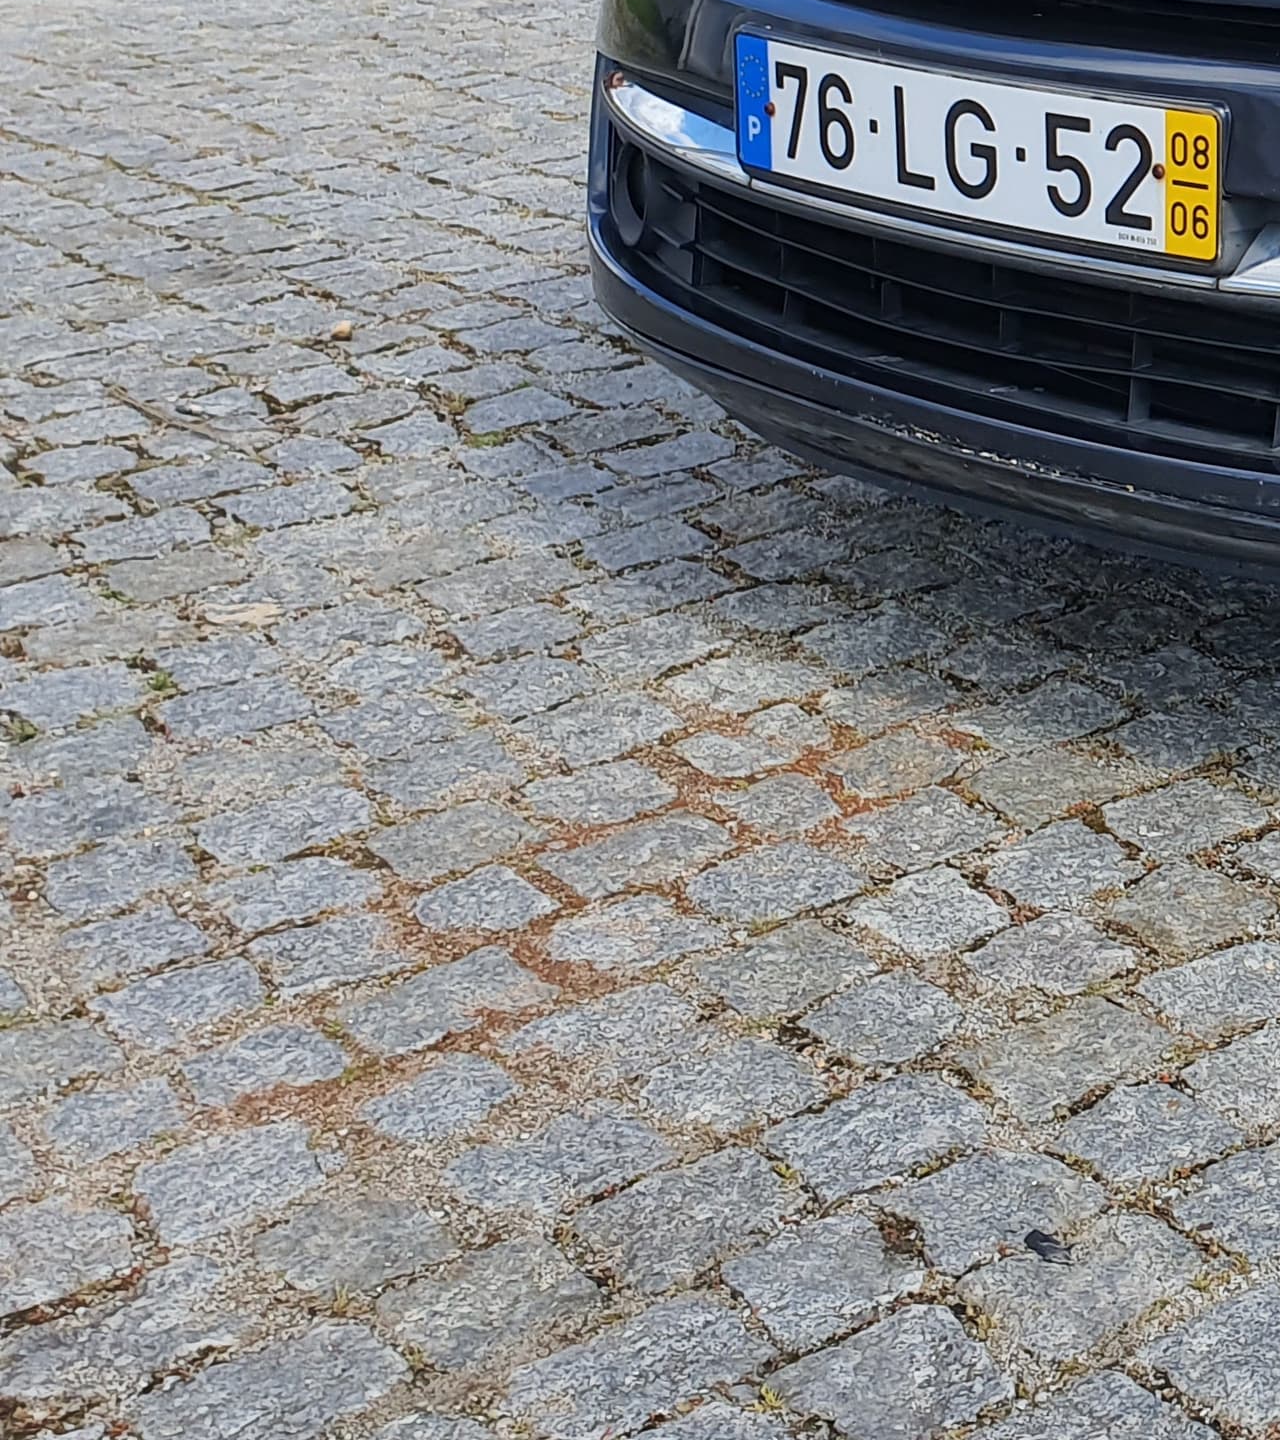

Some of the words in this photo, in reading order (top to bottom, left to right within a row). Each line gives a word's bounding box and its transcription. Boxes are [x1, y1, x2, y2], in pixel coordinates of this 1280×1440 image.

[748, 114, 761, 142] P
[1171, 131, 1210, 170] 08
[1170, 201, 1210, 240] 06
